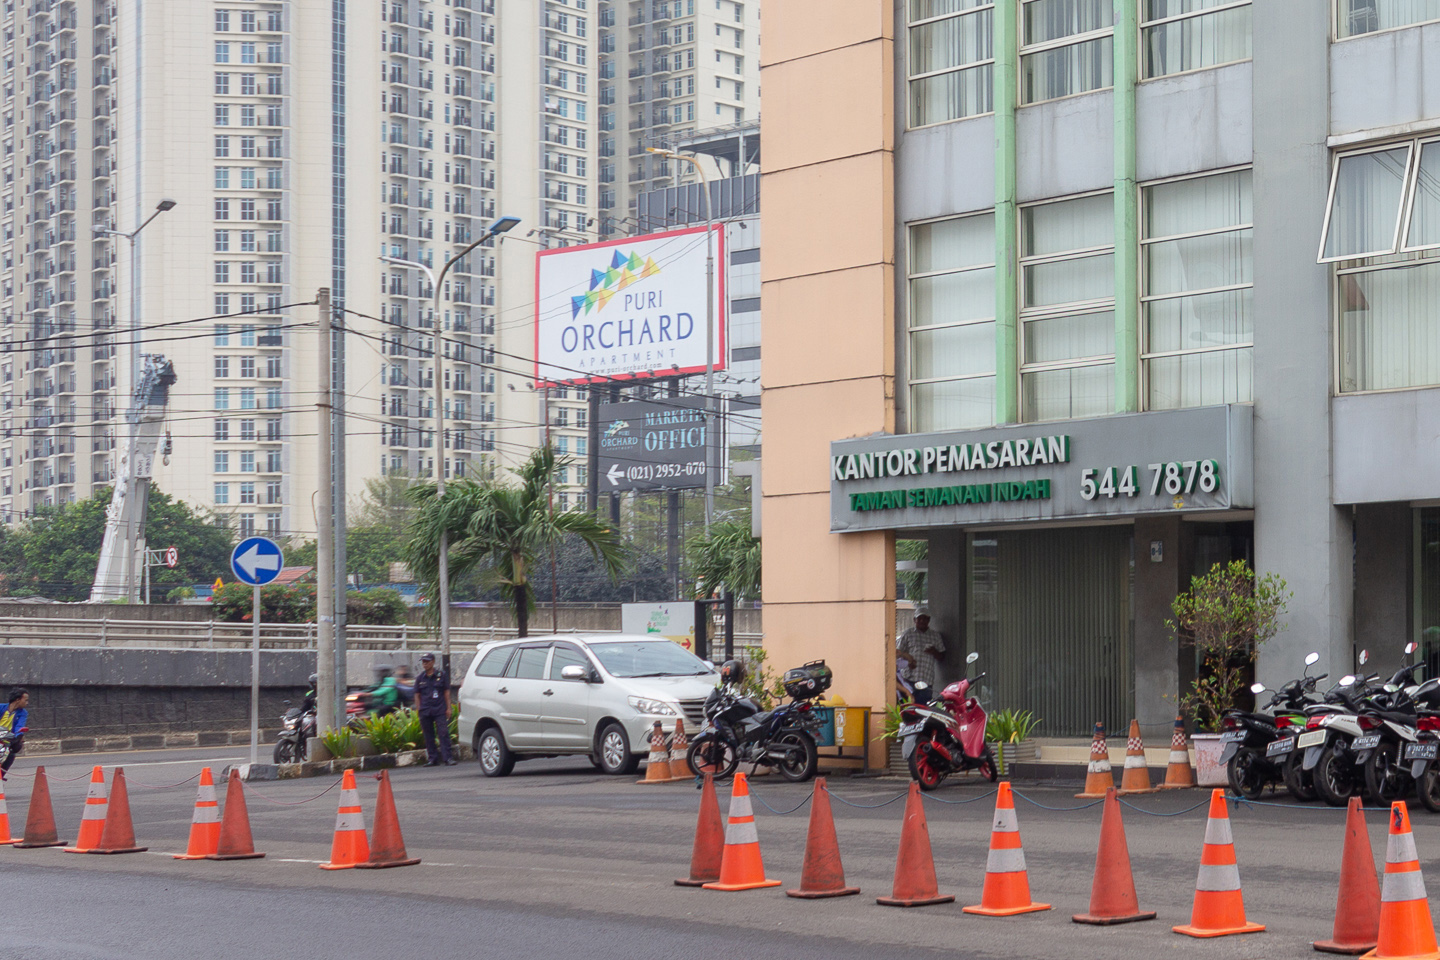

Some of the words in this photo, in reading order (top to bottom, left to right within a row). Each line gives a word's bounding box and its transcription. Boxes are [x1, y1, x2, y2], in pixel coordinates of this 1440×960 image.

[624, 290, 663, 312] PURI
[561, 312, 694, 353] ORCHARD
[579, 348, 677, 368] APARTMENT
[601, 436, 639, 448] ORCHARD
[831, 448, 922, 481] KANTOR
[923, 434, 1070, 474] PEMASARAN
[626, 465, 654, 482] (021)
[1080, 465, 1140, 501] 544
[1147, 458, 1221, 497] 7878
[849, 489, 907, 511] TAMAN
[907, 483, 992, 508] SEMANAN
[993, 479, 1051, 502] INDAH
